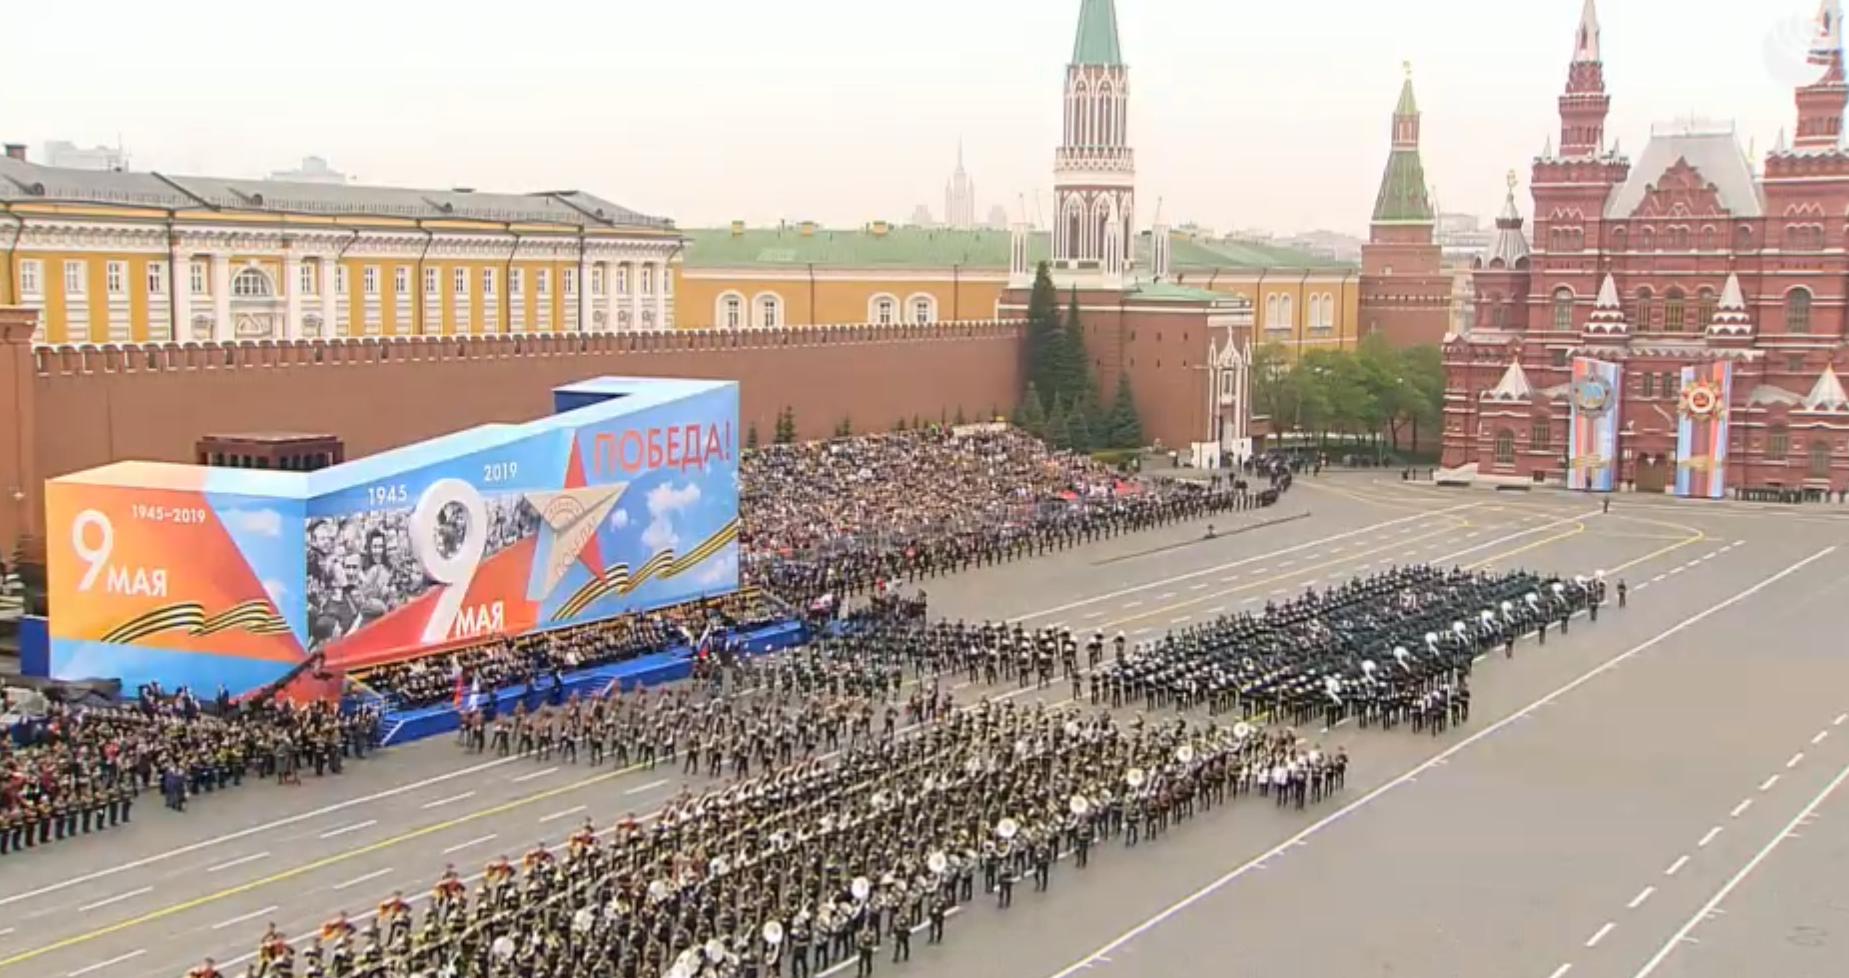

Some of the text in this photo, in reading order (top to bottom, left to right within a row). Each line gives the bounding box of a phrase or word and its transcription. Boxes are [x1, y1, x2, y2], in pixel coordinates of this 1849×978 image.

[595, 421, 730, 474] ПОБЕДА!
[368, 463, 517, 505] 1945 2019
[72, 508, 168, 596] 9 МАЯ
[408, 478, 504, 643] 9 МАЯ
